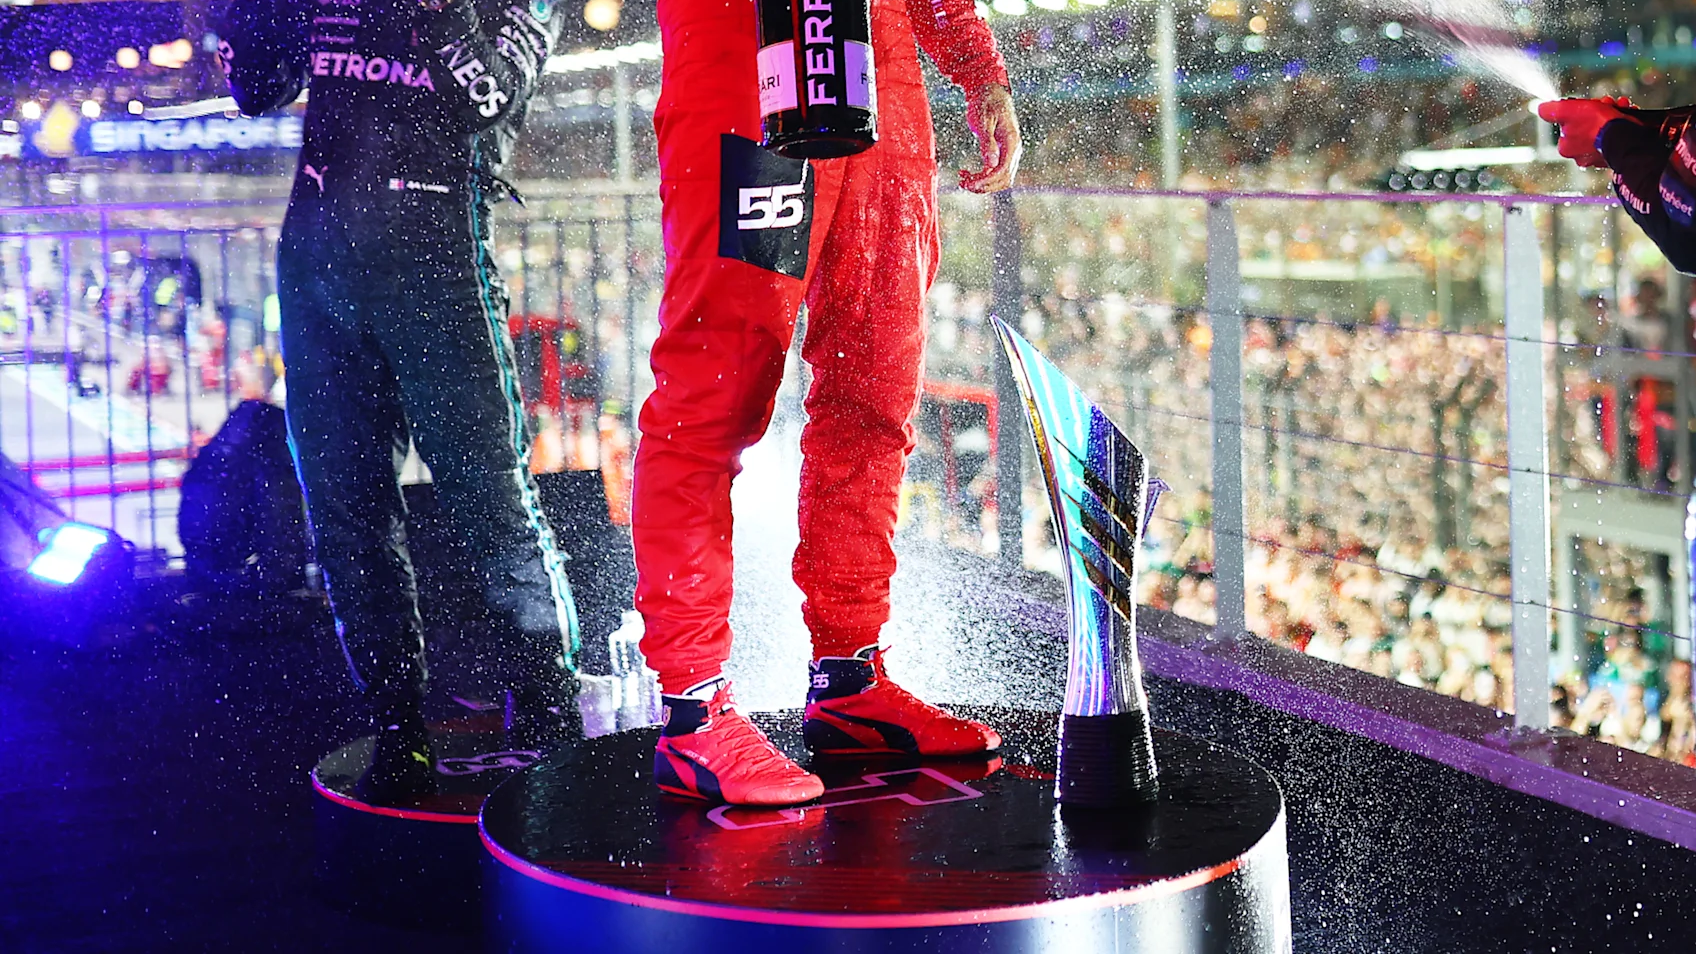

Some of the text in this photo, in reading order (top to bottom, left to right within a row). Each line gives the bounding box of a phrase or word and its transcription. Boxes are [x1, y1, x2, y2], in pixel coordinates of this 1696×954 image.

[309, 51, 436, 92] ETRONA
[737, 183, 805, 230] 55
[1658, 183, 1694, 217] rtsheet
[812, 673, 830, 689] 55
